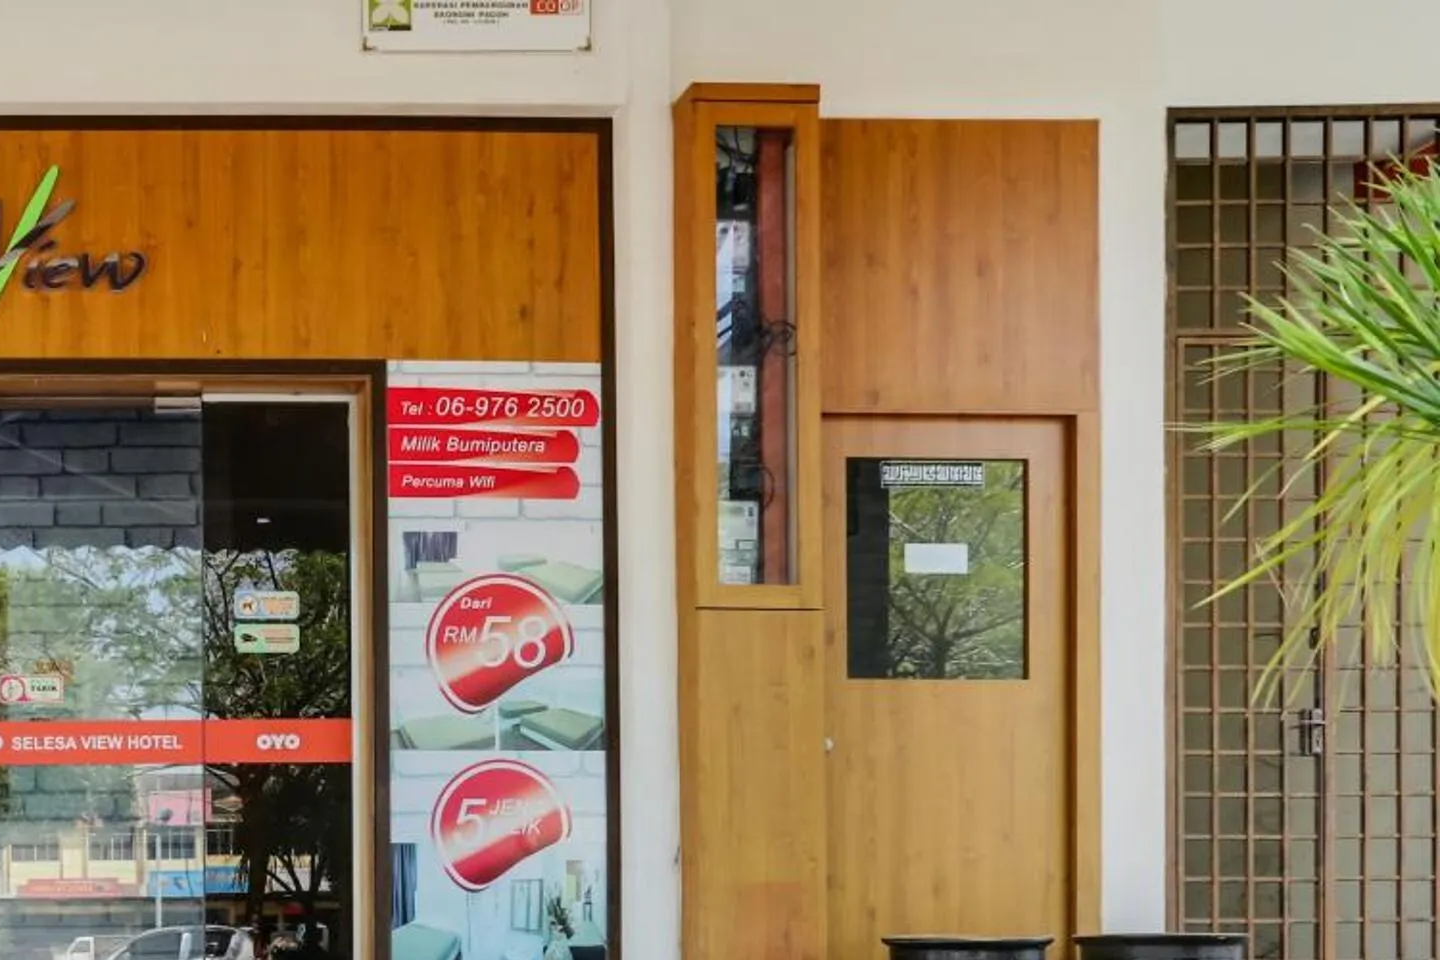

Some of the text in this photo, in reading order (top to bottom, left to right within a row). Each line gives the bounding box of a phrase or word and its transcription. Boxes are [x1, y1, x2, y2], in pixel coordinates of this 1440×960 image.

[435, 396, 518, 417] 06-976
[527, 397, 585, 418] 2500
[400, 435, 546, 455] Milik Bumiputera
[401, 475, 495, 488] Percuma Wifi
[460, 596, 493, 610] Dari
[10, 735, 78, 752] SELESA
[80, 734, 125, 751] VIEW
[128, 733, 184, 750] HOTEL
[256, 733, 302, 751] OYO
[454, 798, 489, 846] 5
